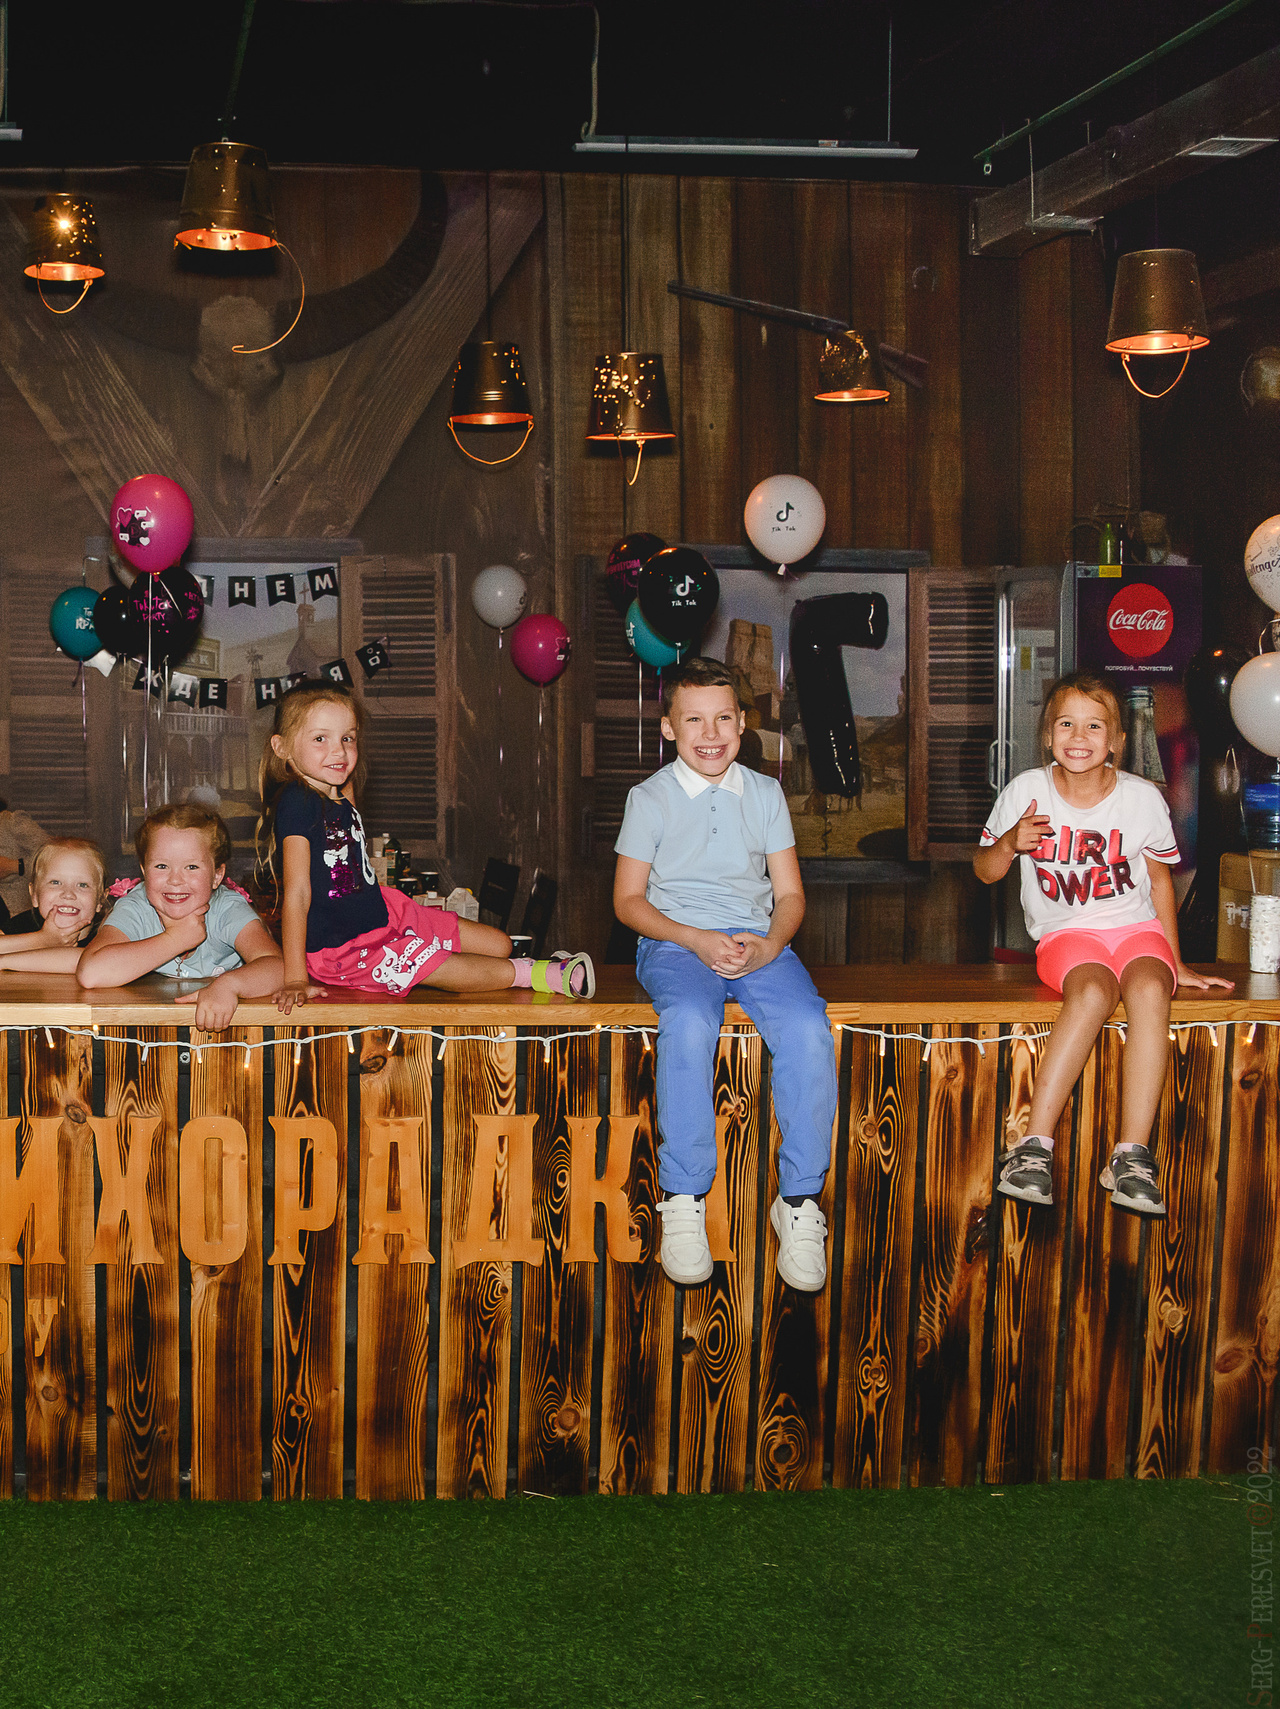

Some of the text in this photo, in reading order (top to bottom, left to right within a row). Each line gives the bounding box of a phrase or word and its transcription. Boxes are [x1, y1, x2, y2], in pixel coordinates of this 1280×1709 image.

[1108, 609, 1170, 631] Coca-Cola
[1027, 824, 1127, 866] GIRL
[1036, 861, 1136, 906] OWER
